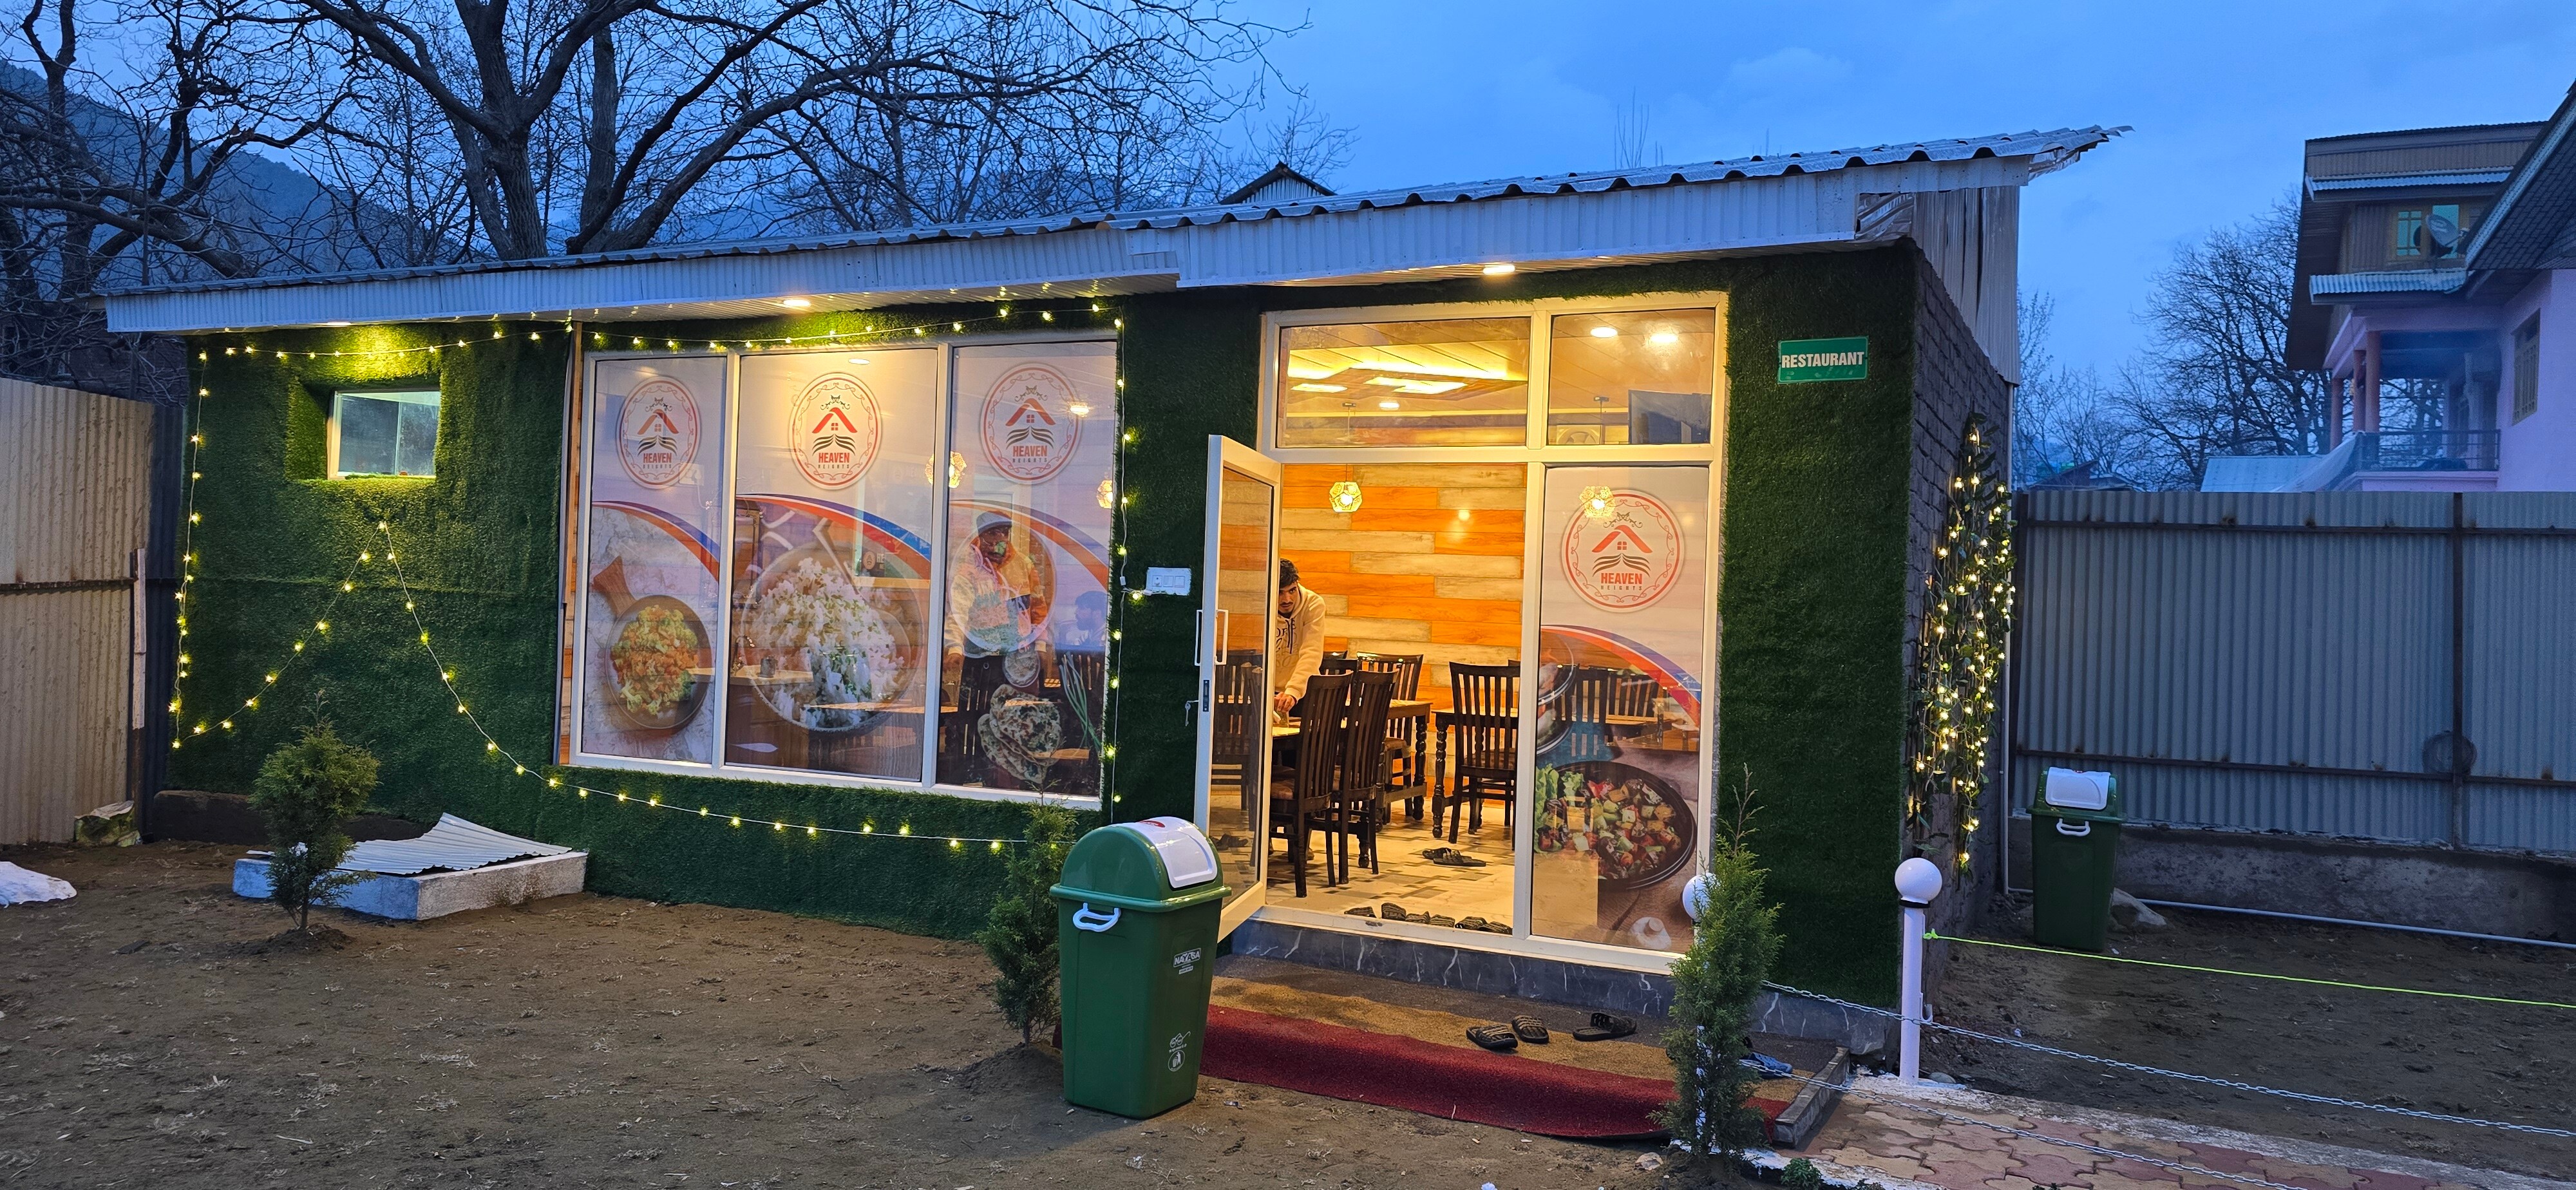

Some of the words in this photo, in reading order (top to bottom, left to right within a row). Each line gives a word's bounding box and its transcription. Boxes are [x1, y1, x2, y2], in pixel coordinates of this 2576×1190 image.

[1781, 352, 1864, 368] RESTAURANT
[1012, 445, 1048, 457] HEAVEN
[643, 453, 672, 463] HEAVEN
[818, 453, 850, 463] HEAVEN
[1600, 572, 1643, 585] HEAVEN
